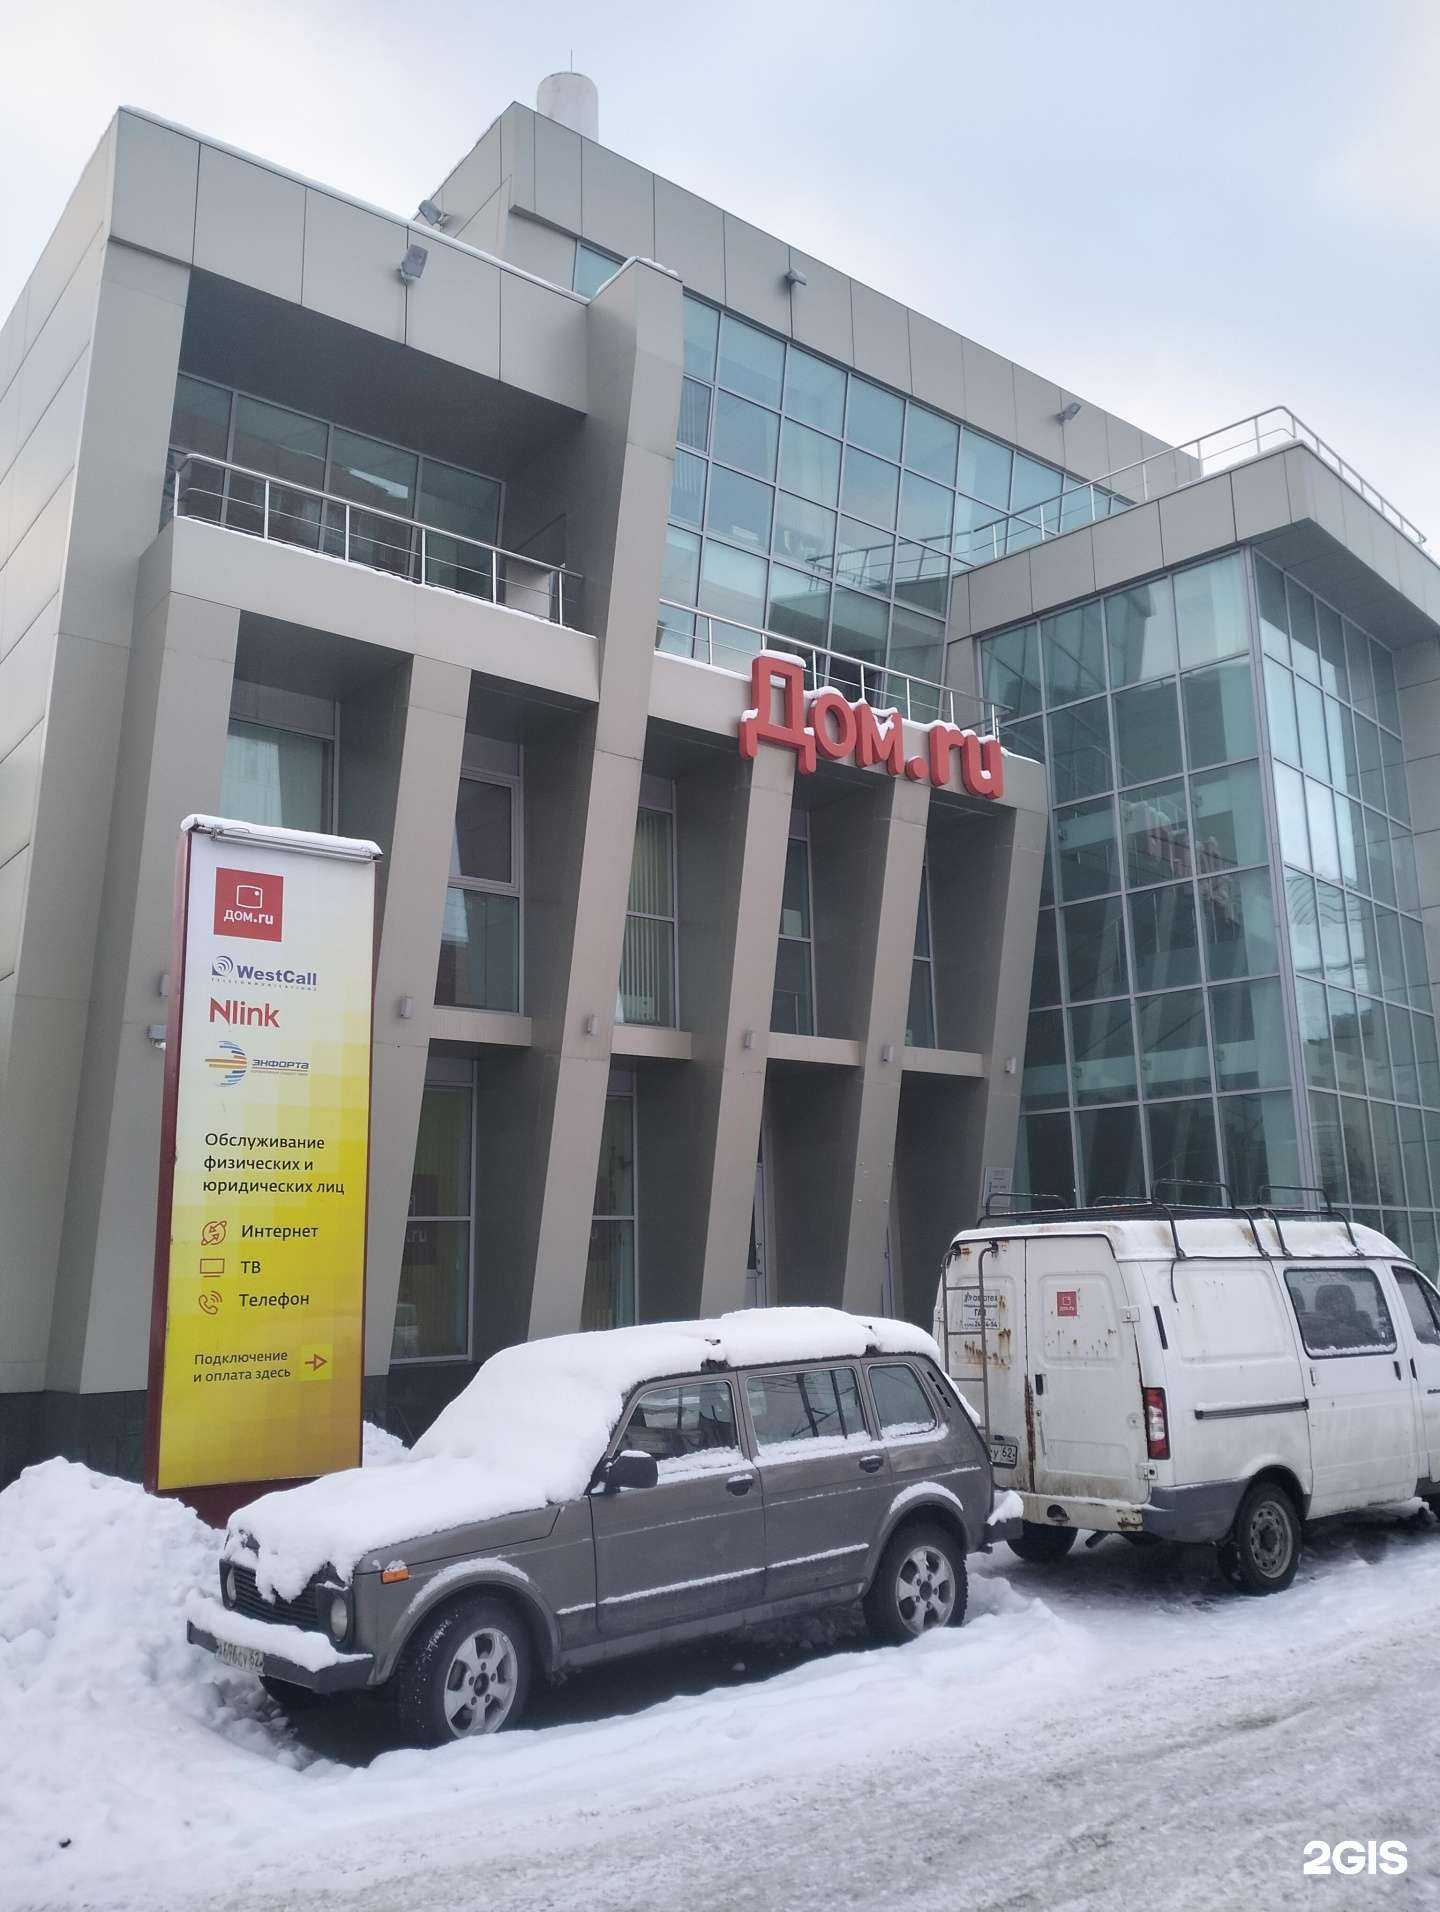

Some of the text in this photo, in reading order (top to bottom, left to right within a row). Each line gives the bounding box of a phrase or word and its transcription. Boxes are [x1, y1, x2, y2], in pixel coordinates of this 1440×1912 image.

[739, 653, 1004, 799] Дом.ru
[236, 964, 317, 986] WestCall
[209, 997, 280, 1028] Nlink
[205, 1132, 325, 1150] Обслуживание
[203, 1155, 313, 1172] физических и
[202, 1179, 345, 1195] юридических лиц
[241, 1224, 319, 1241] Интернет
[240, 1260, 261, 1274] ТВ
[238, 1292, 310, 1308] Телефон
[194, 1350, 288, 1367] Подключение
[193, 1367, 291, 1383] и оплата здесь
